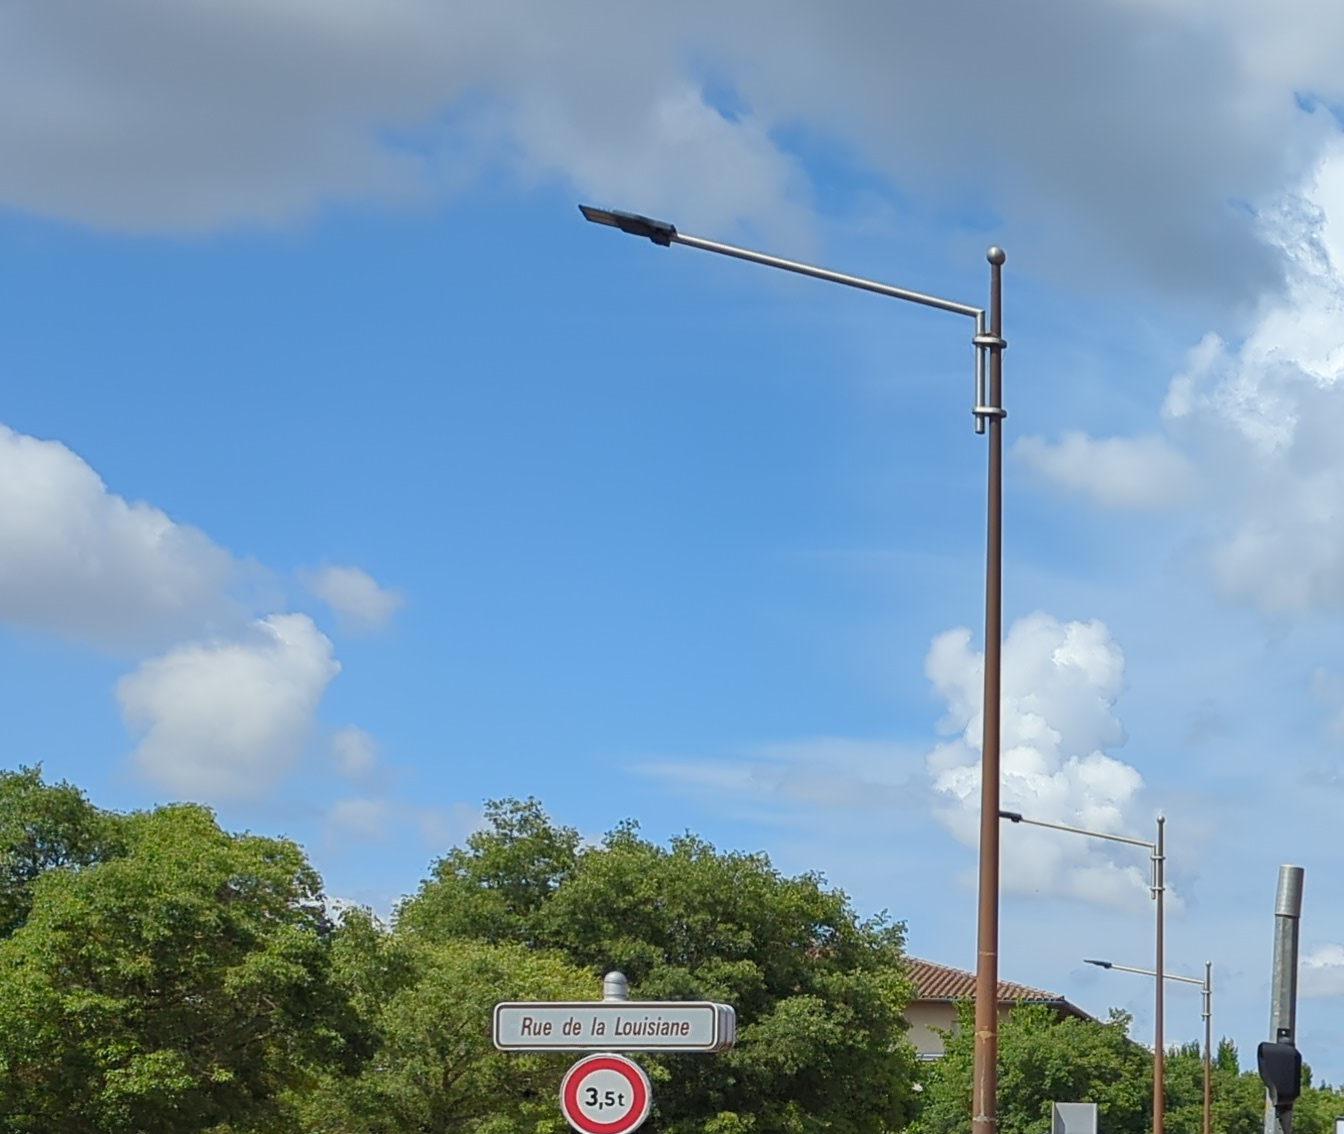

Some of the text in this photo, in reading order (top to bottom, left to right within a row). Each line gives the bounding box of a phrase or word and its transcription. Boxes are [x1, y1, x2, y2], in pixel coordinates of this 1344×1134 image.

[521, 1016, 690, 1036] Rue de la Louisiane
